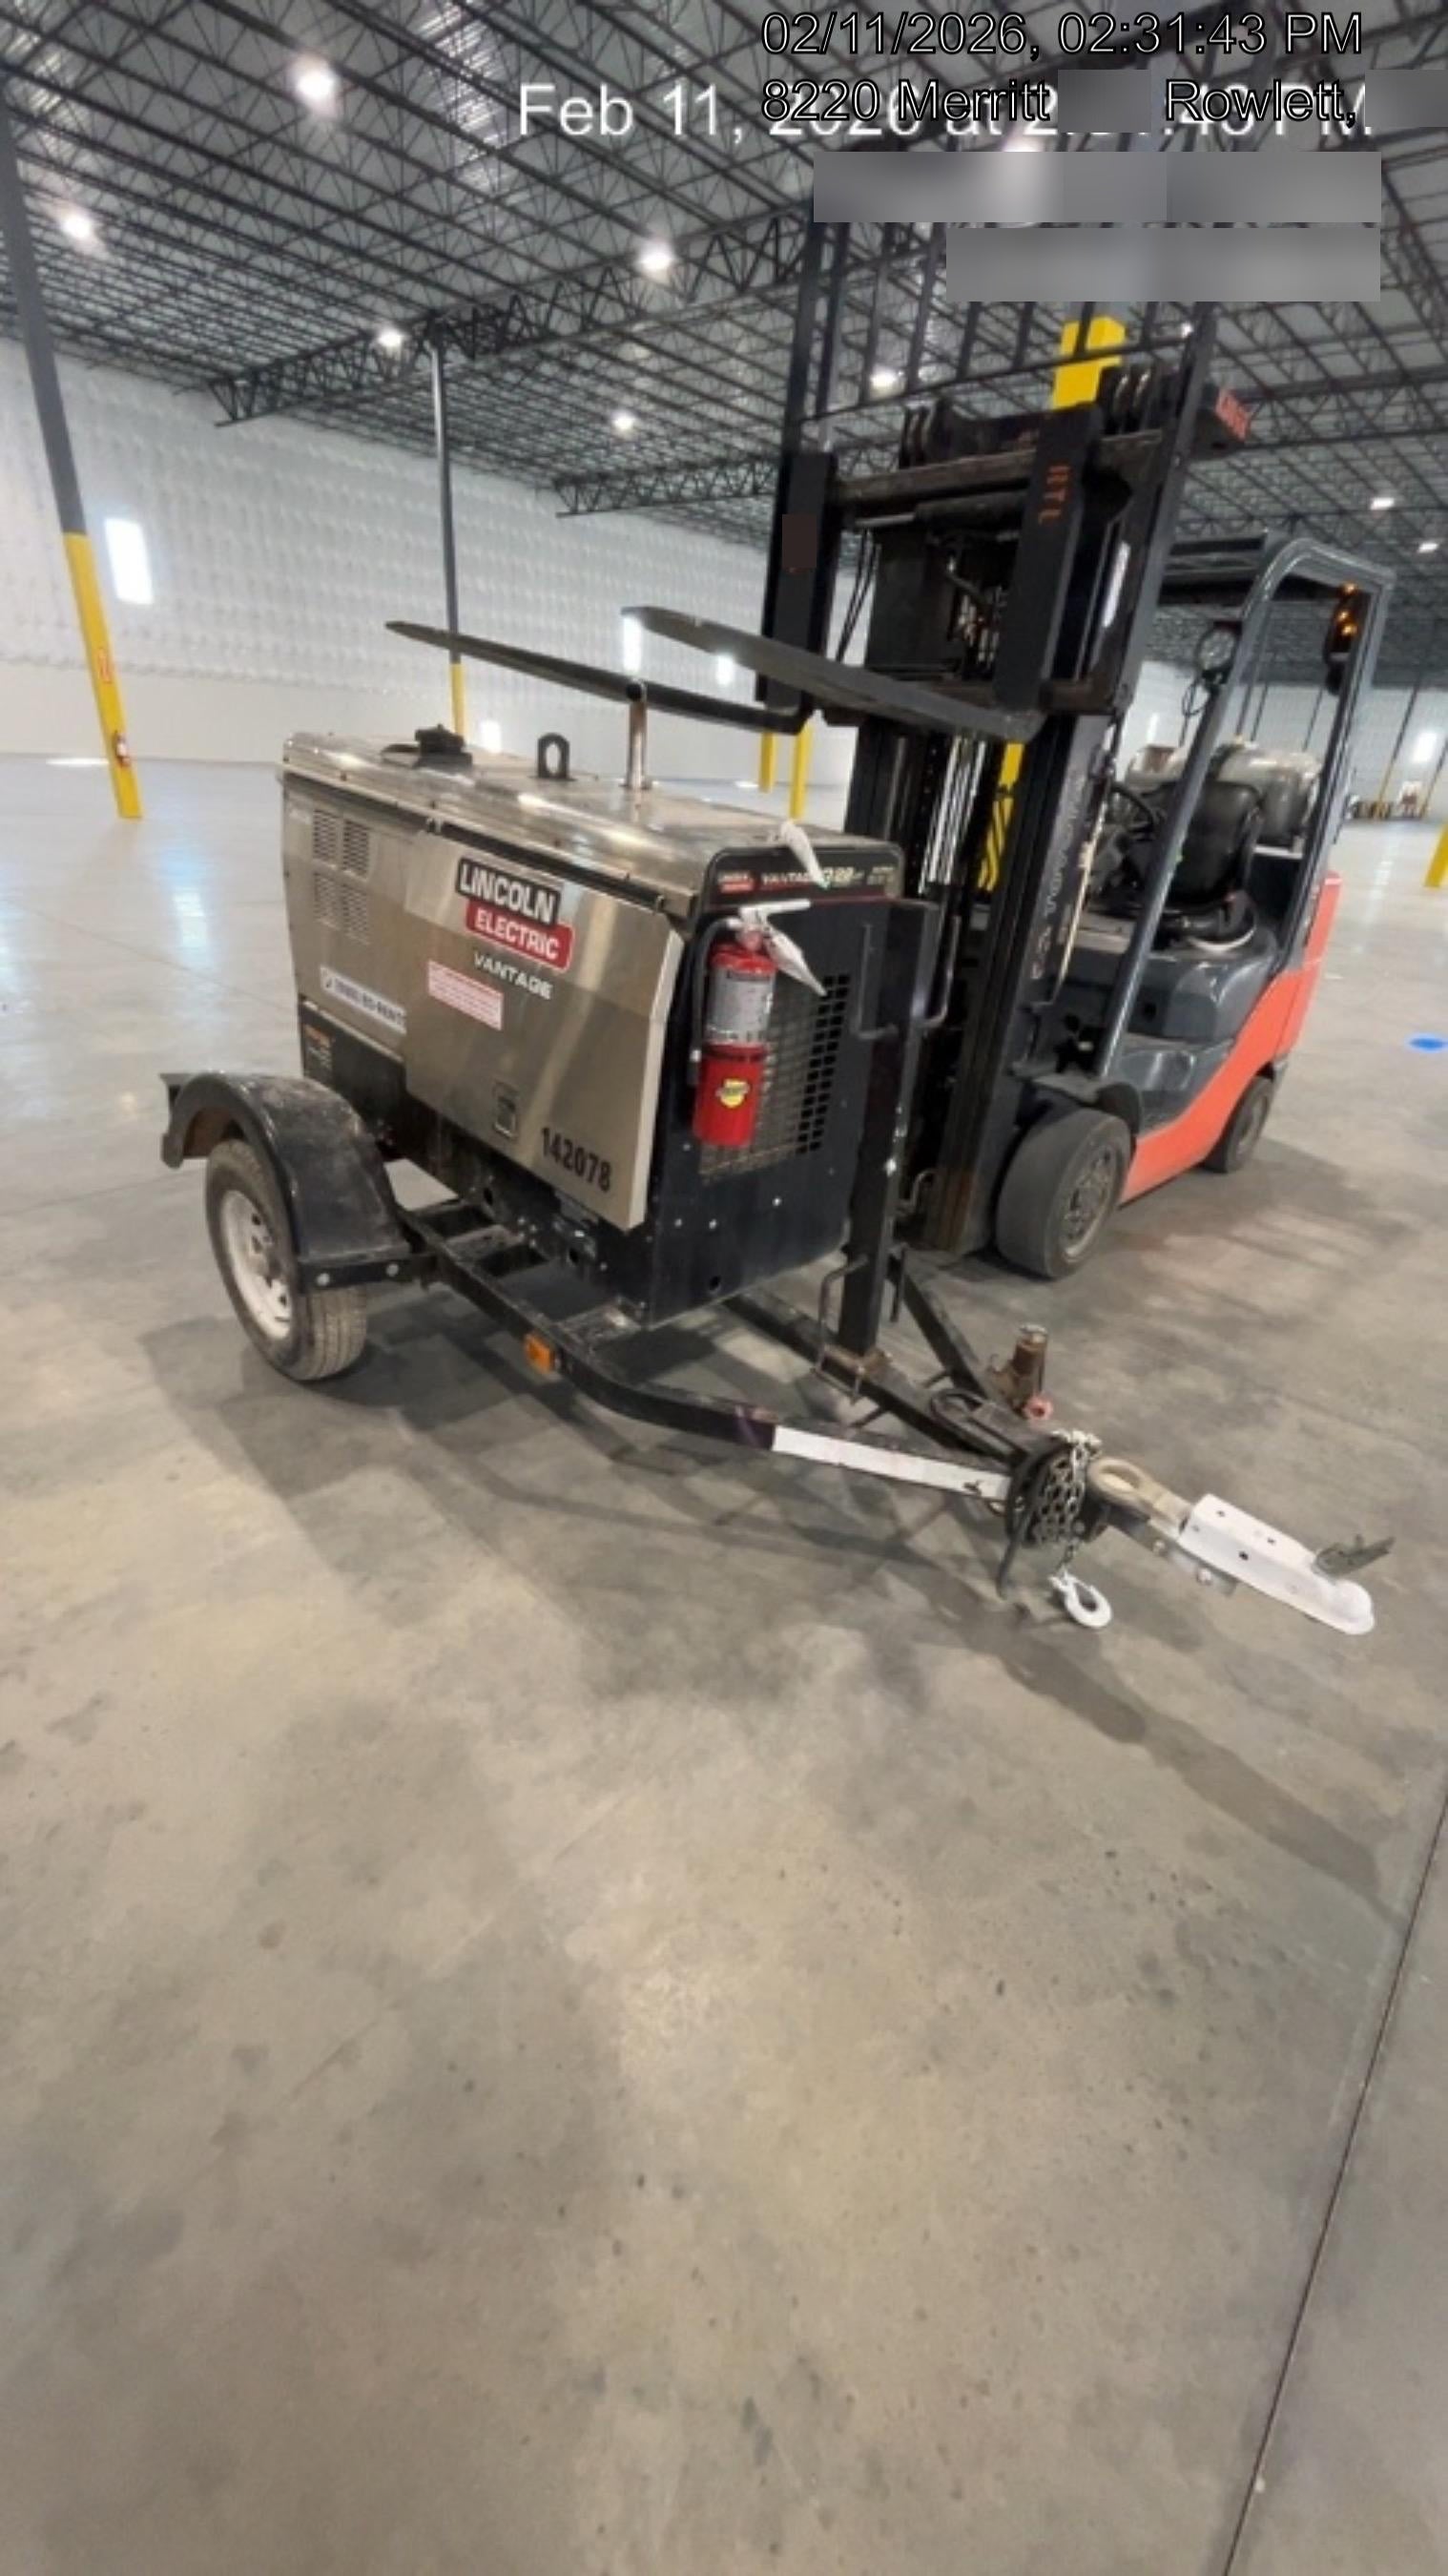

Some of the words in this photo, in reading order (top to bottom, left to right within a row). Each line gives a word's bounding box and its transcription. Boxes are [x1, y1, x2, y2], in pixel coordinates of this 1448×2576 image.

[459, 862, 554, 925] LINCOLN
[474, 906, 560, 961] ELECTRIC
[473, 950, 553, 1001] VANTAGE
[541, 1127, 611, 1193] 142078
